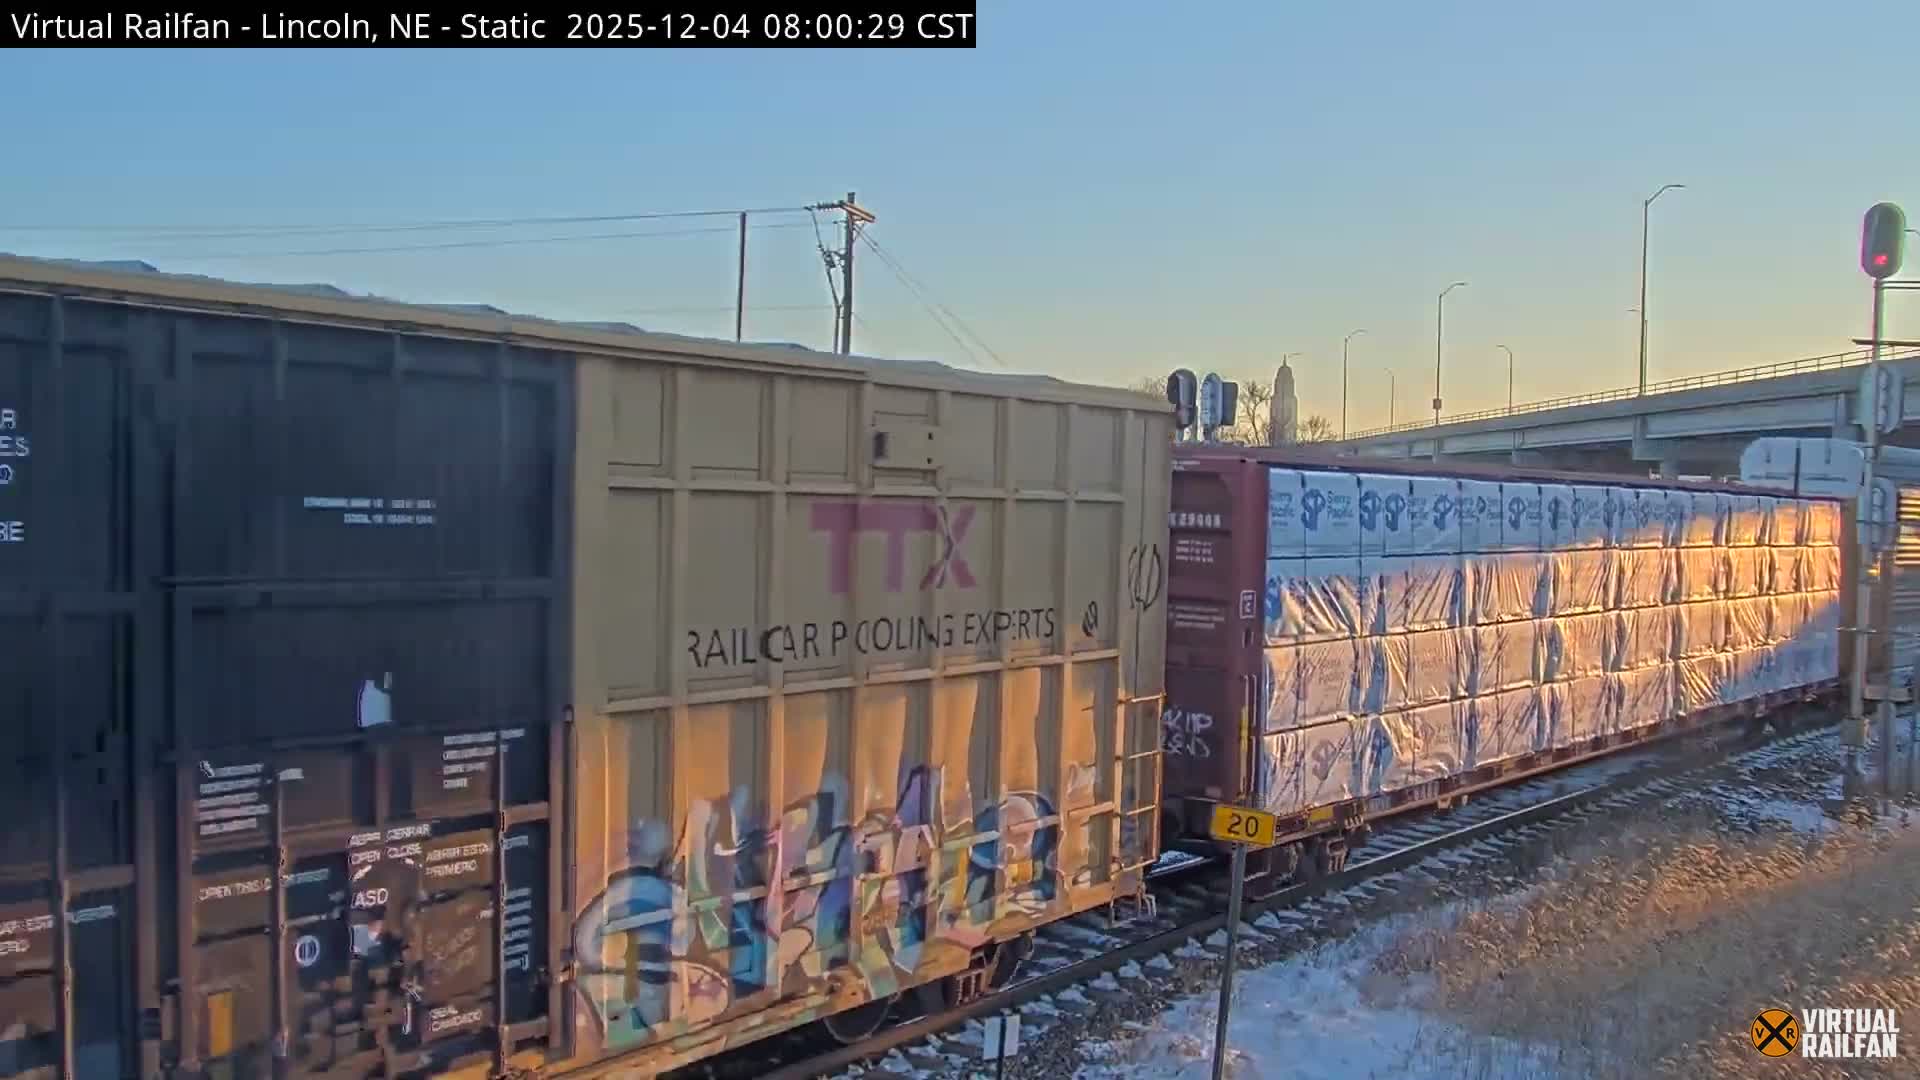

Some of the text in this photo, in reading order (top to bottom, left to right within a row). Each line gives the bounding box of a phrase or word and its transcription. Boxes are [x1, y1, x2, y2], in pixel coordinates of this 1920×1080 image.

[811, 501, 977, 594] TTX
[687, 622, 821, 668] RAILCAR
[1227, 812, 1260, 838] 20
